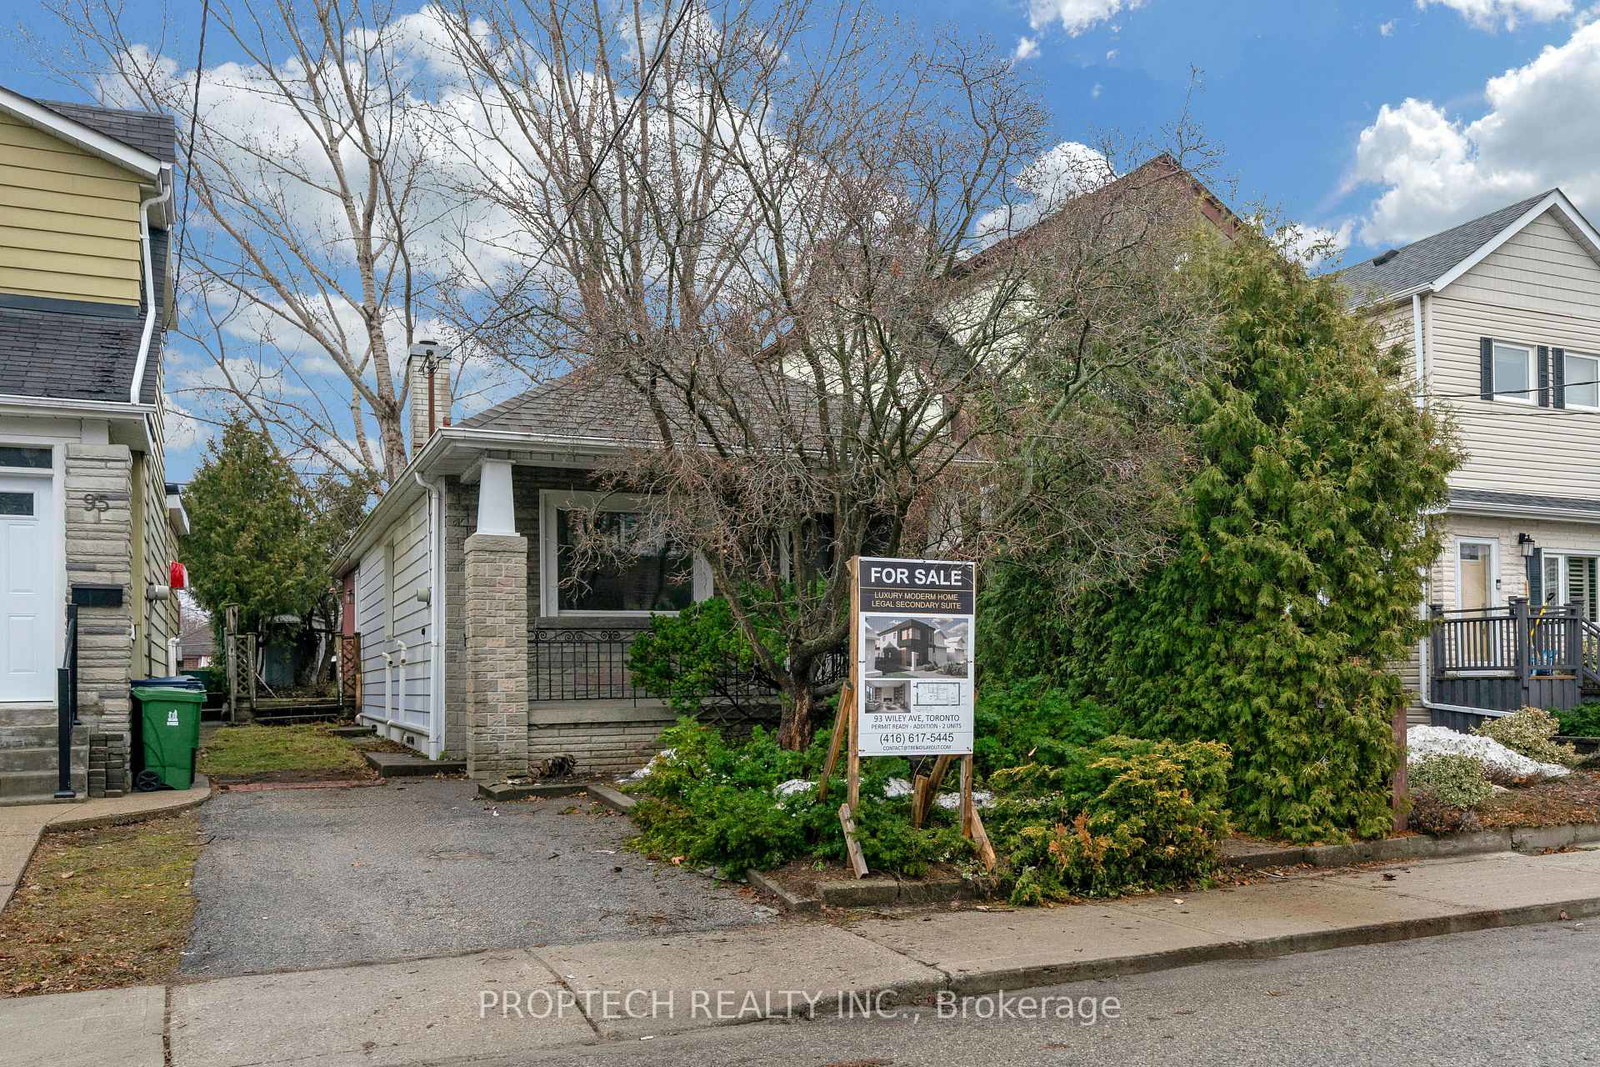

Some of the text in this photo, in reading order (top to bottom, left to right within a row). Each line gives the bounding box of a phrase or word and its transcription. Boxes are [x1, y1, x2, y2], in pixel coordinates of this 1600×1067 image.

[84, 494, 109, 512] 95
[871, 567, 962, 586] FOR SALE
[874, 591, 903, 599] LUXURY
[937, 593, 959, 601] HOME
[871, 600, 962, 610] LEGAL SECONDARY SUITE
[873, 714, 960, 723] 93 WILEY AVE, TORONTO
[879, 732, 954, 745] (416) 617-5445
